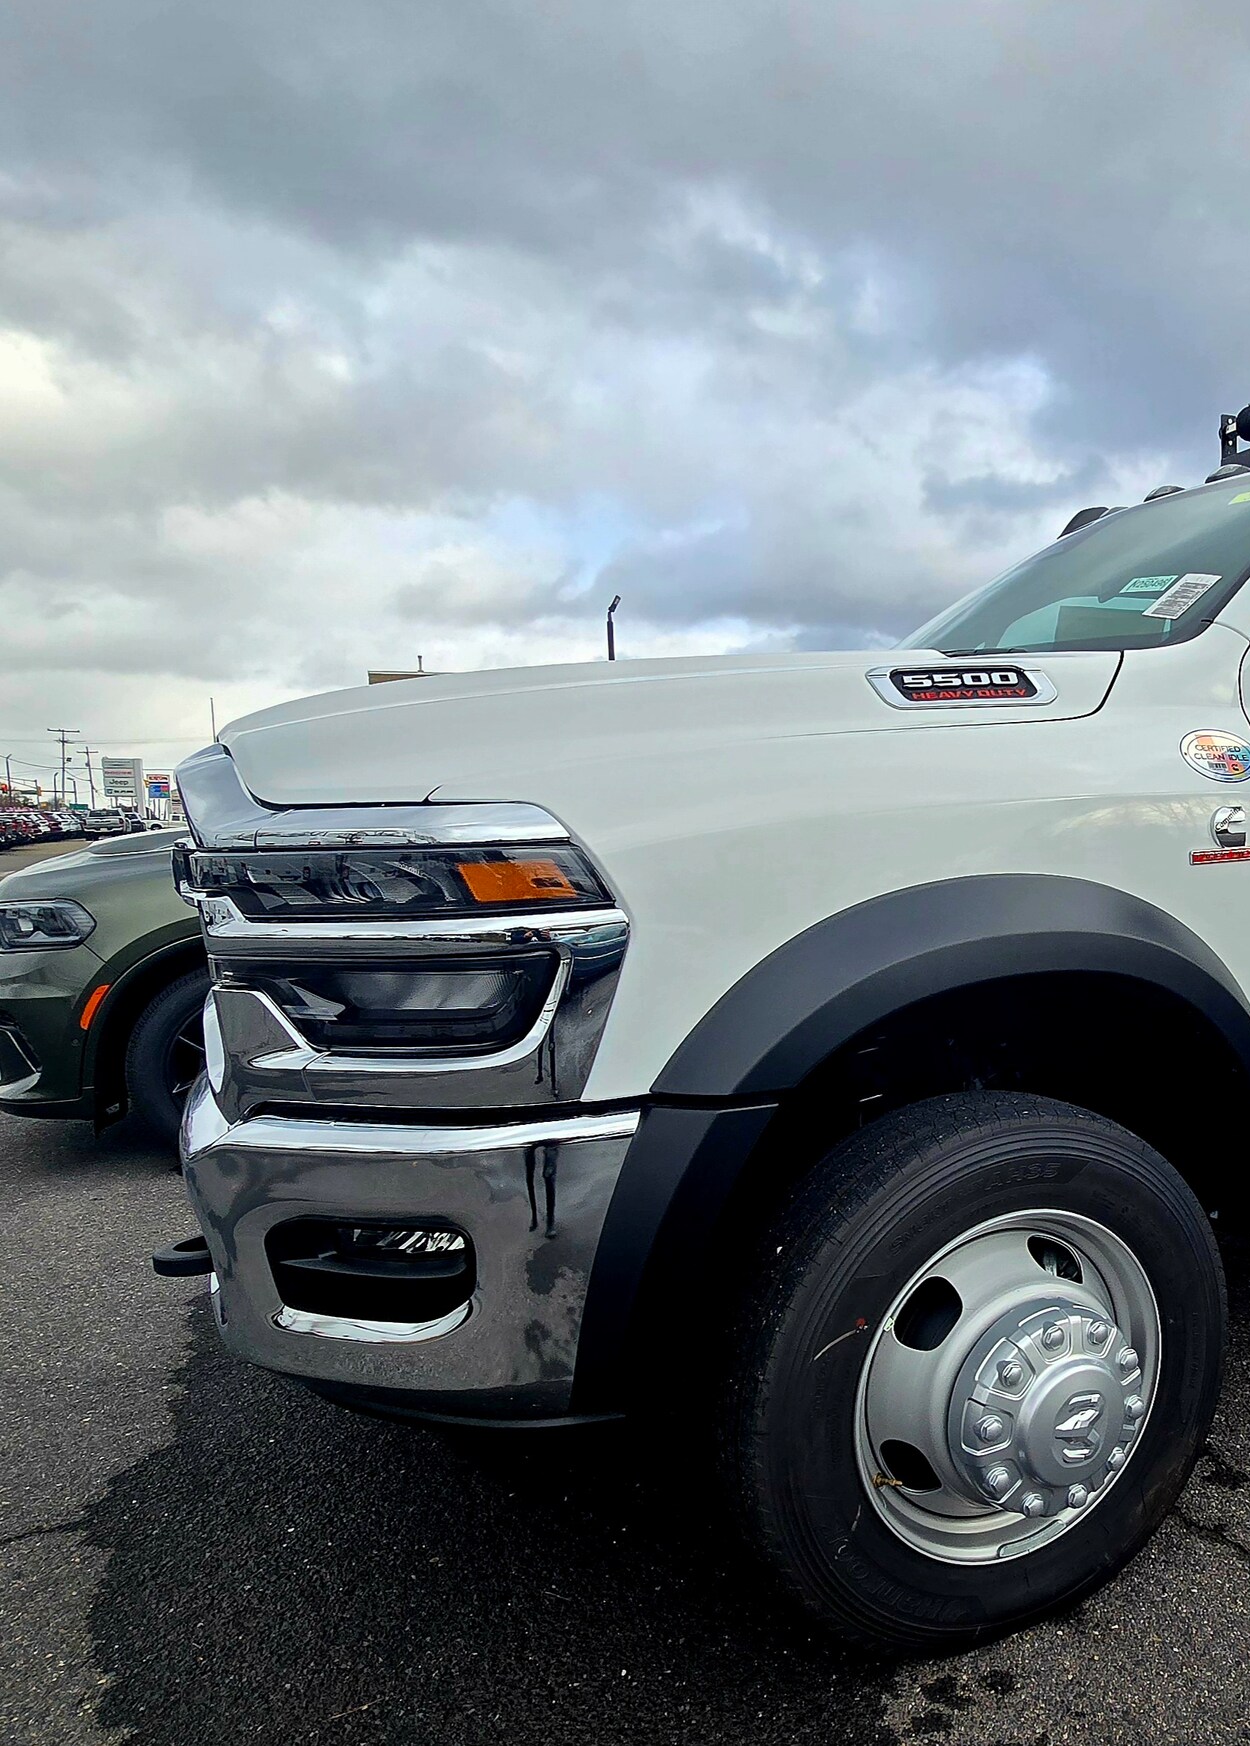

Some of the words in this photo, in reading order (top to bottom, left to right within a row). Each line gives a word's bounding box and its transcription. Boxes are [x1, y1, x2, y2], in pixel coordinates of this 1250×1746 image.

[902, 671, 1019, 688] 5500
[911, 690, 976, 700] HEAVY
[977, 688, 1028, 698] DUTY
[1194, 744, 1241, 753] CERTIFIED
[1193, 752, 1225, 760] CLEAN
[1227, 753, 1250, 761] IDLE
